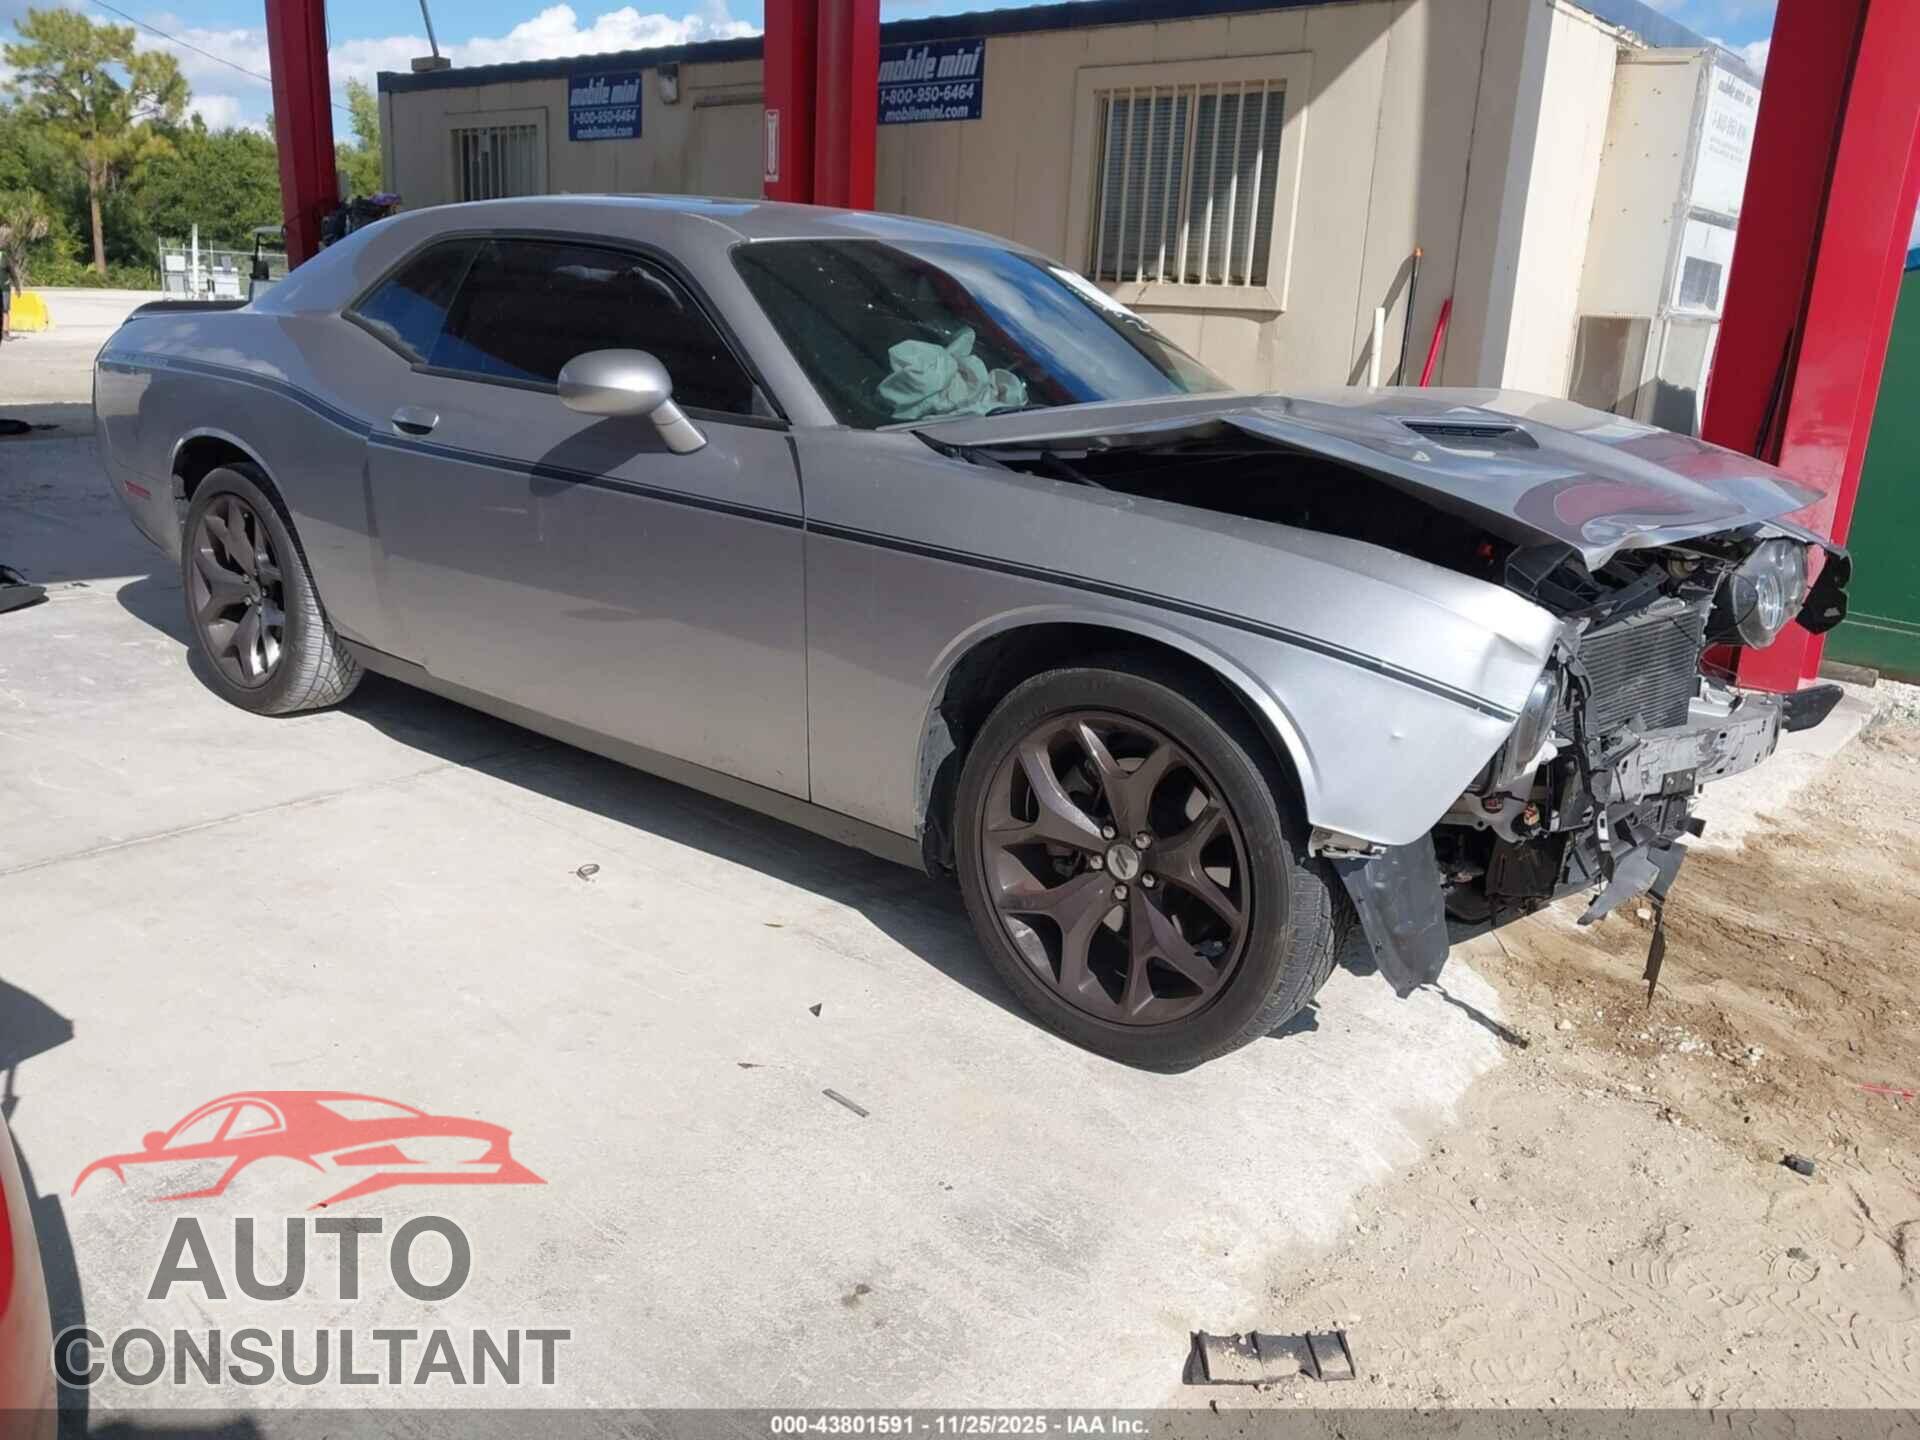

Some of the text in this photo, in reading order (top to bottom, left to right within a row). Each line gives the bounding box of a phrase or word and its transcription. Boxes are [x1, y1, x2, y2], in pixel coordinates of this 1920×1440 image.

[879, 41, 983, 82] mobile mini
[881, 83, 975, 104] 1-800-950-6464
[885, 104, 969, 122] mobilemini.com
